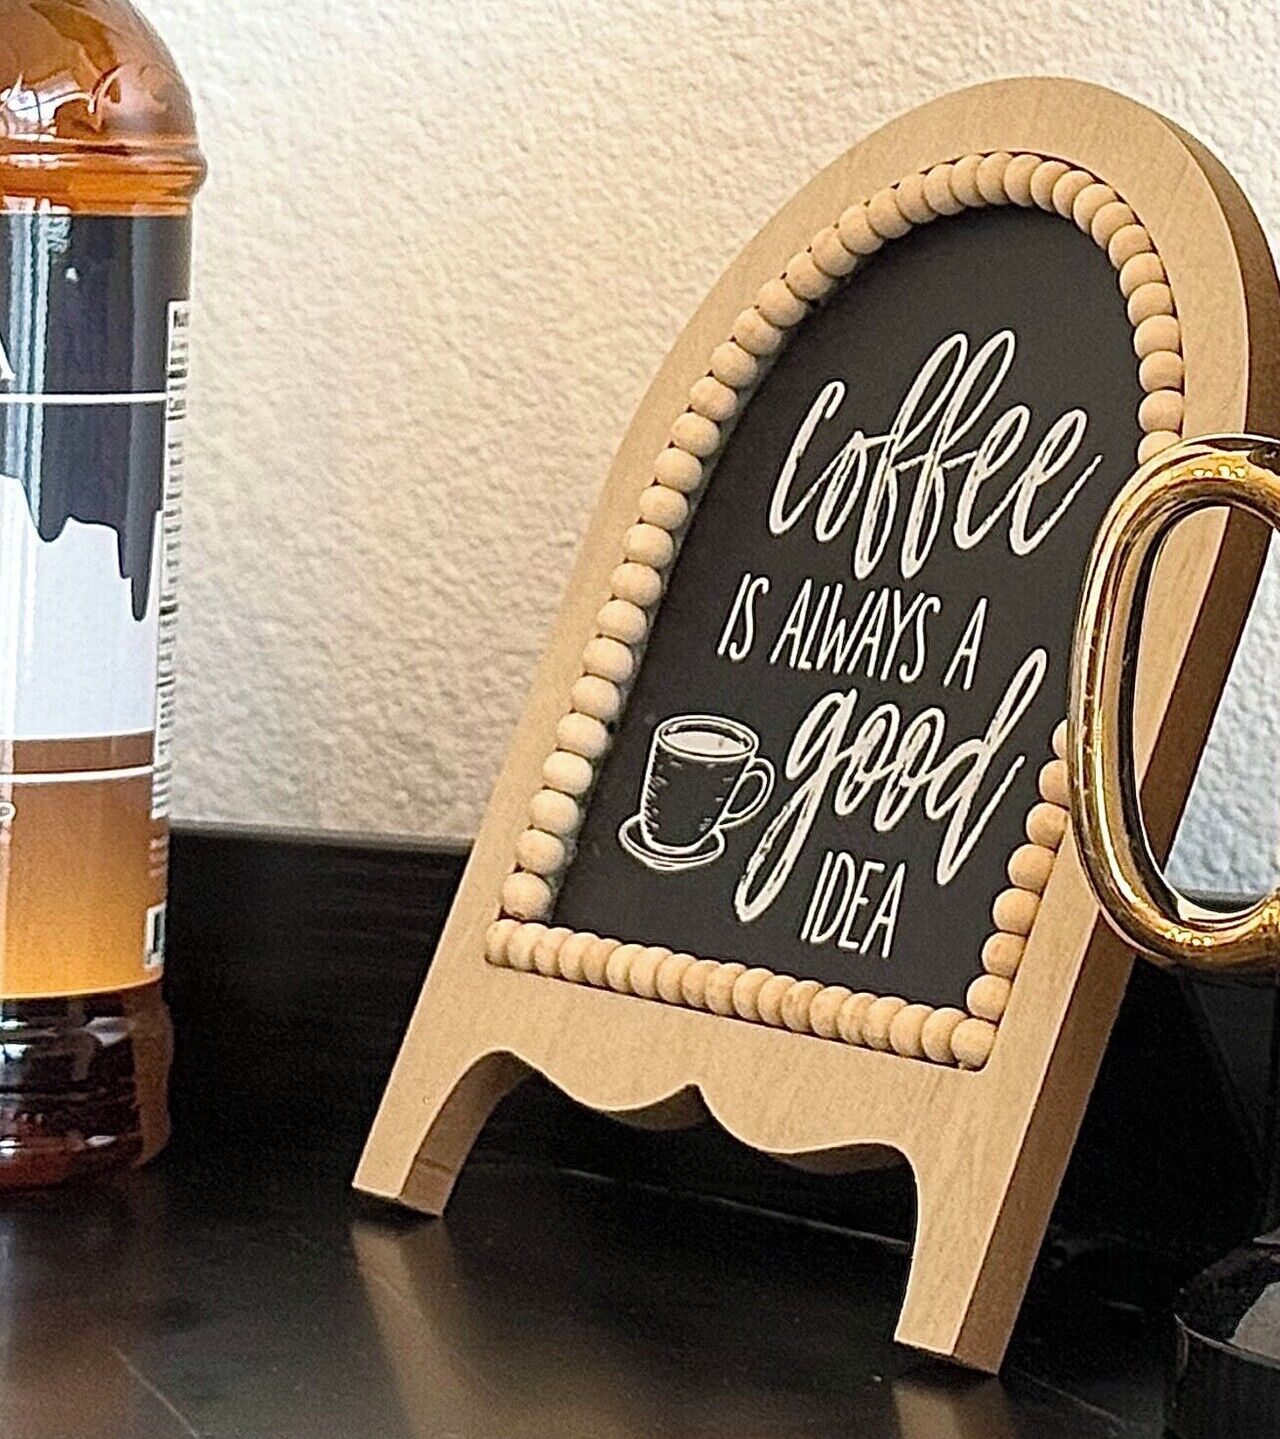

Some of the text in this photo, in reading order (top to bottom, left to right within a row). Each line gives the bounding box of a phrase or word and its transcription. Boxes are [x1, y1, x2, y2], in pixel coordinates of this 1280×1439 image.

[718, 572, 989, 690] IS ALWAYS A
[732, 648, 1048, 923] good
[800, 850, 907, 959] IDEA
